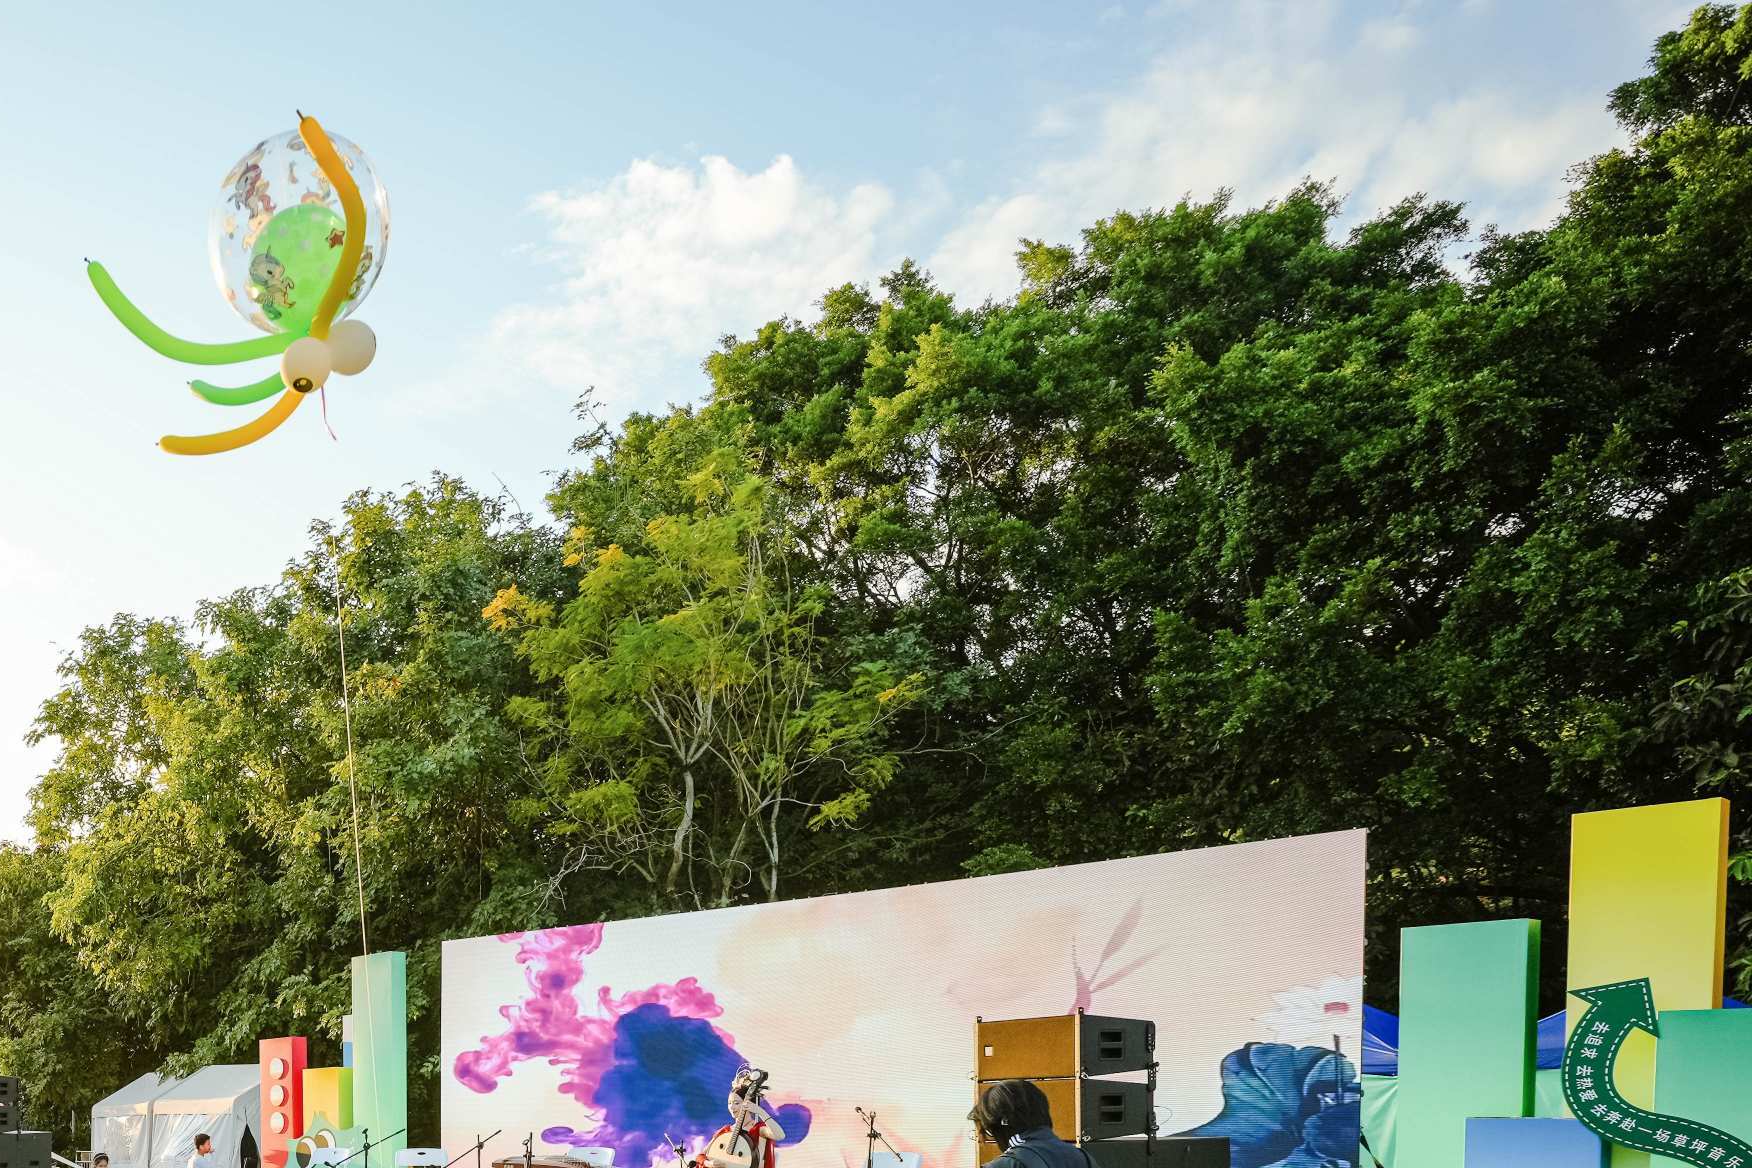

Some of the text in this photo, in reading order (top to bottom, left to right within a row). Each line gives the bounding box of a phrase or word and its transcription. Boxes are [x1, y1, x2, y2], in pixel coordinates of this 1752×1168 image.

[1580, 1020, 1610, 1060] 去追求
[1575, 1064, 1599, 1102] 去热爱
